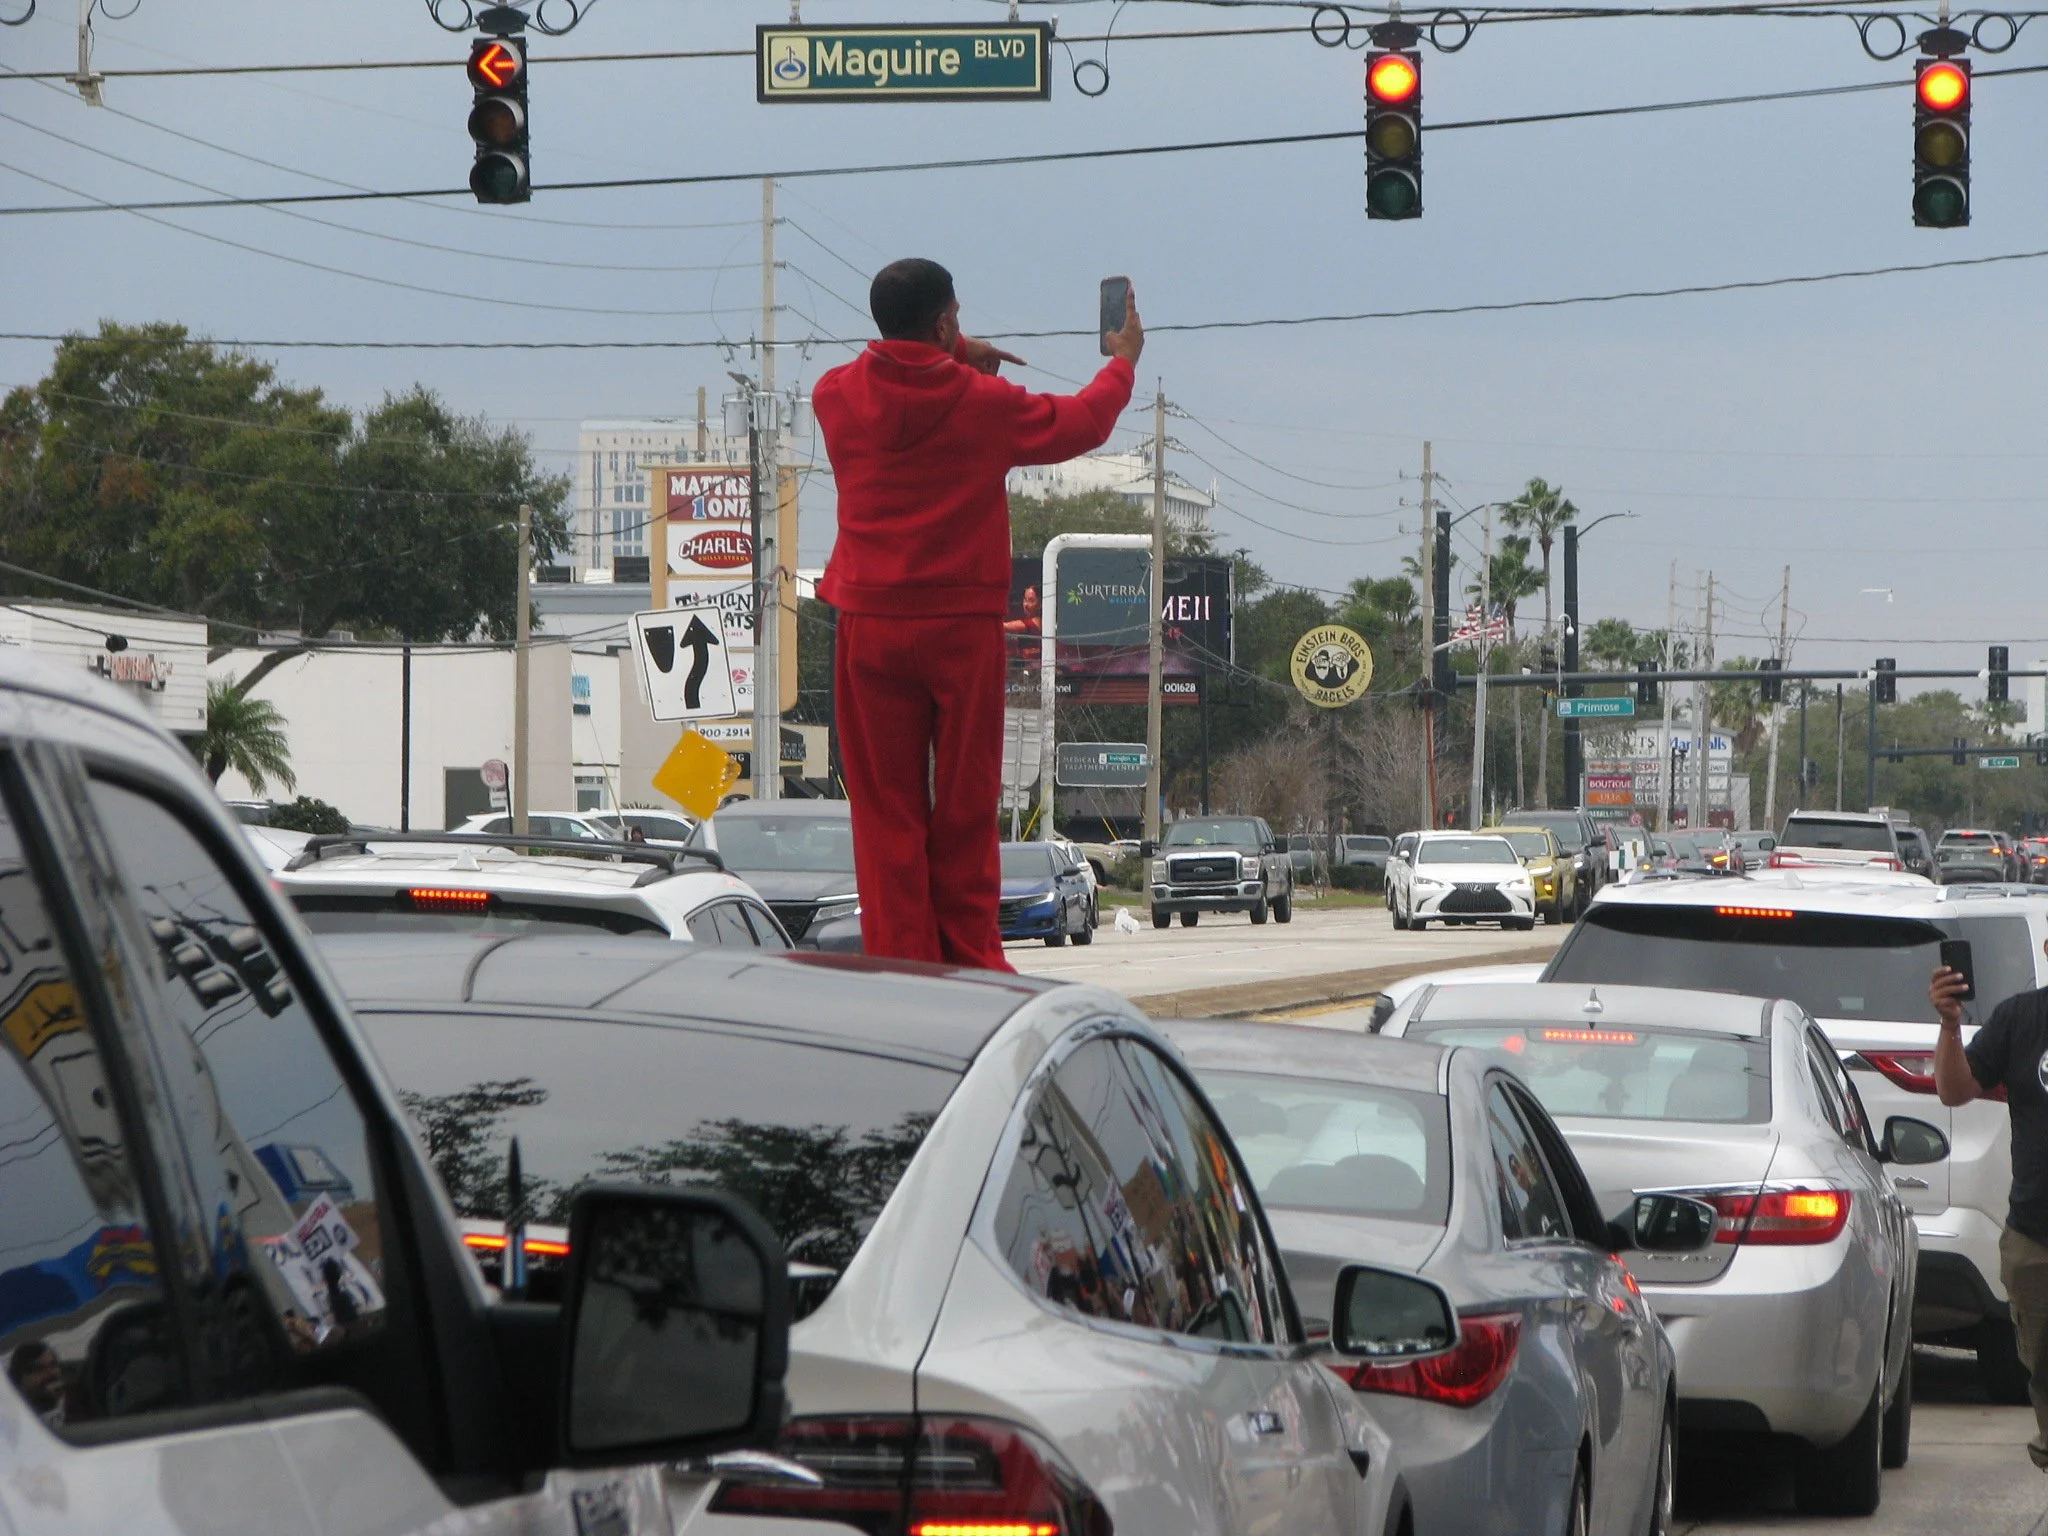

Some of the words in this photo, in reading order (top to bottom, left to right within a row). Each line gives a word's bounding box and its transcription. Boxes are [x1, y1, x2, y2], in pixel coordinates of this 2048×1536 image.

[815, 40, 961, 87] Maguire
[974, 39, 1026, 58] BLVD
[1077, 582, 1146, 600] SURTERRA
[1296, 631, 1336, 662] EINSTEIN
[1340, 632, 1365, 657] BROS
[1164, 683, 1196, 692] 001628
[1316, 686, 1355, 702] BAGELS
[1577, 702, 1620, 713] Primrose
[1589, 779, 1632, 789] BOUTIQUE
